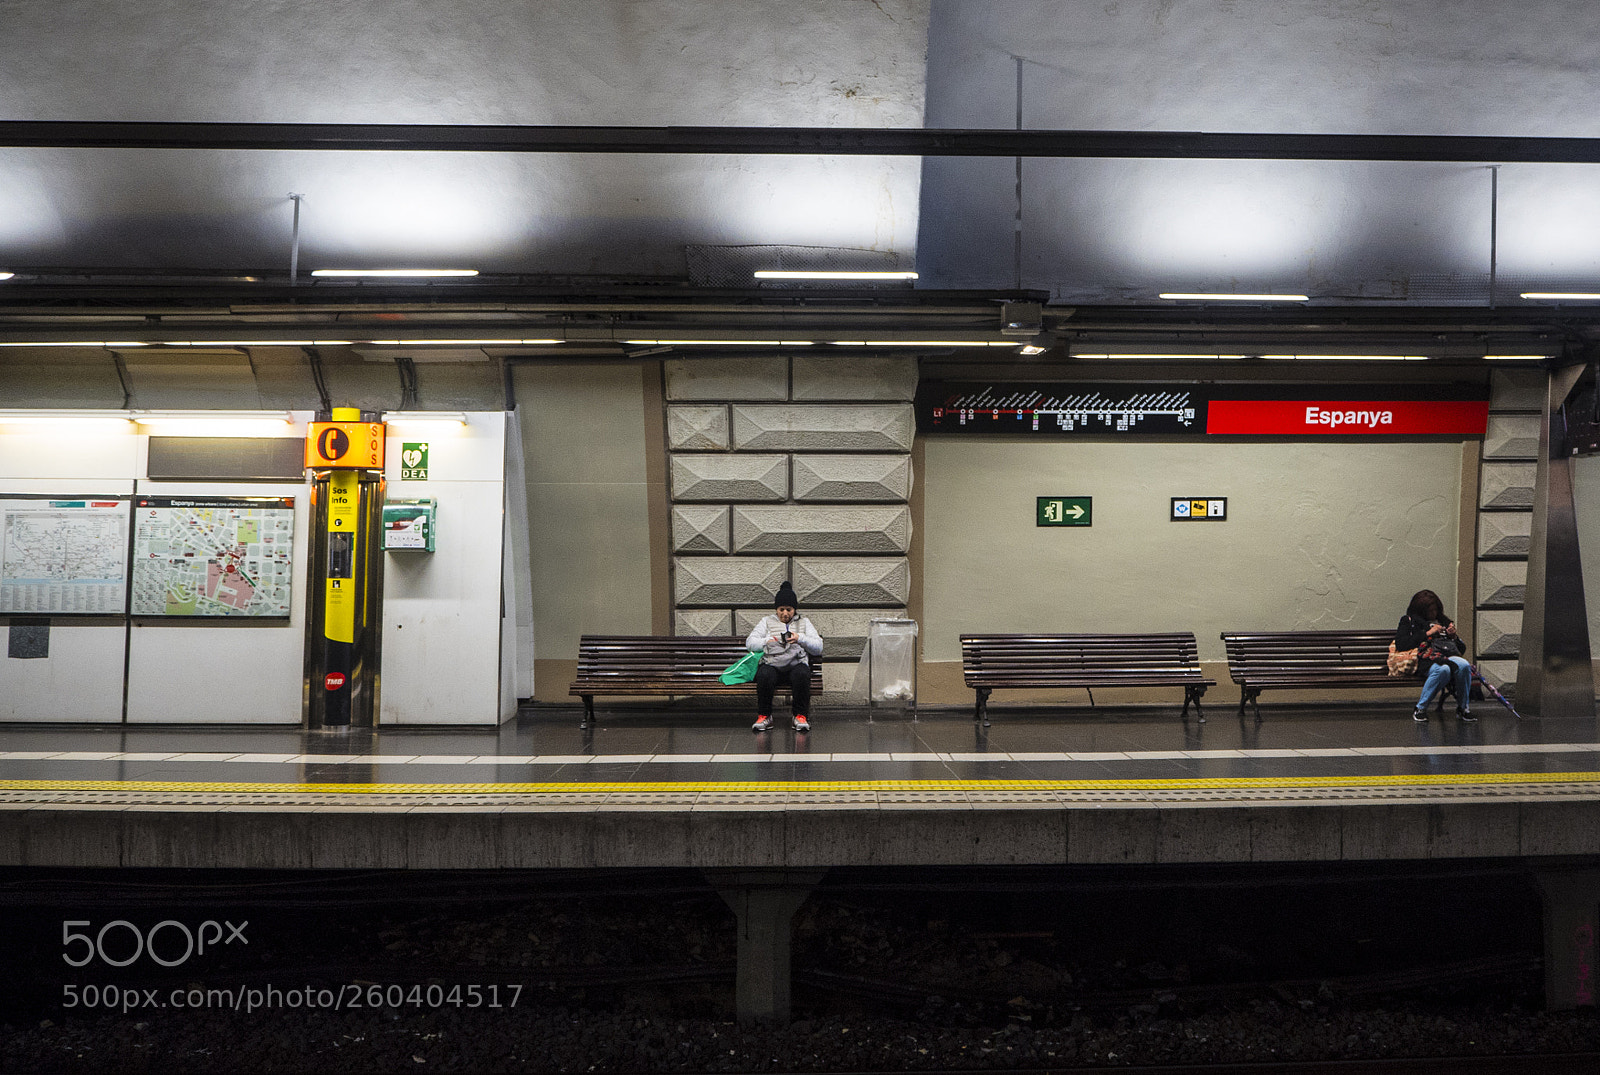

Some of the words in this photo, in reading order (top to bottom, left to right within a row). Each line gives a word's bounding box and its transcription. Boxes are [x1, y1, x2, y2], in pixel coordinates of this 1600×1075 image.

[1305, 406, 1393, 428] Espanya
[370, 425, 378, 465] SOS
[402, 469, 427, 478] DEA
[332, 487, 348, 495] Sos
[170, 499, 195, 507] Espanya
